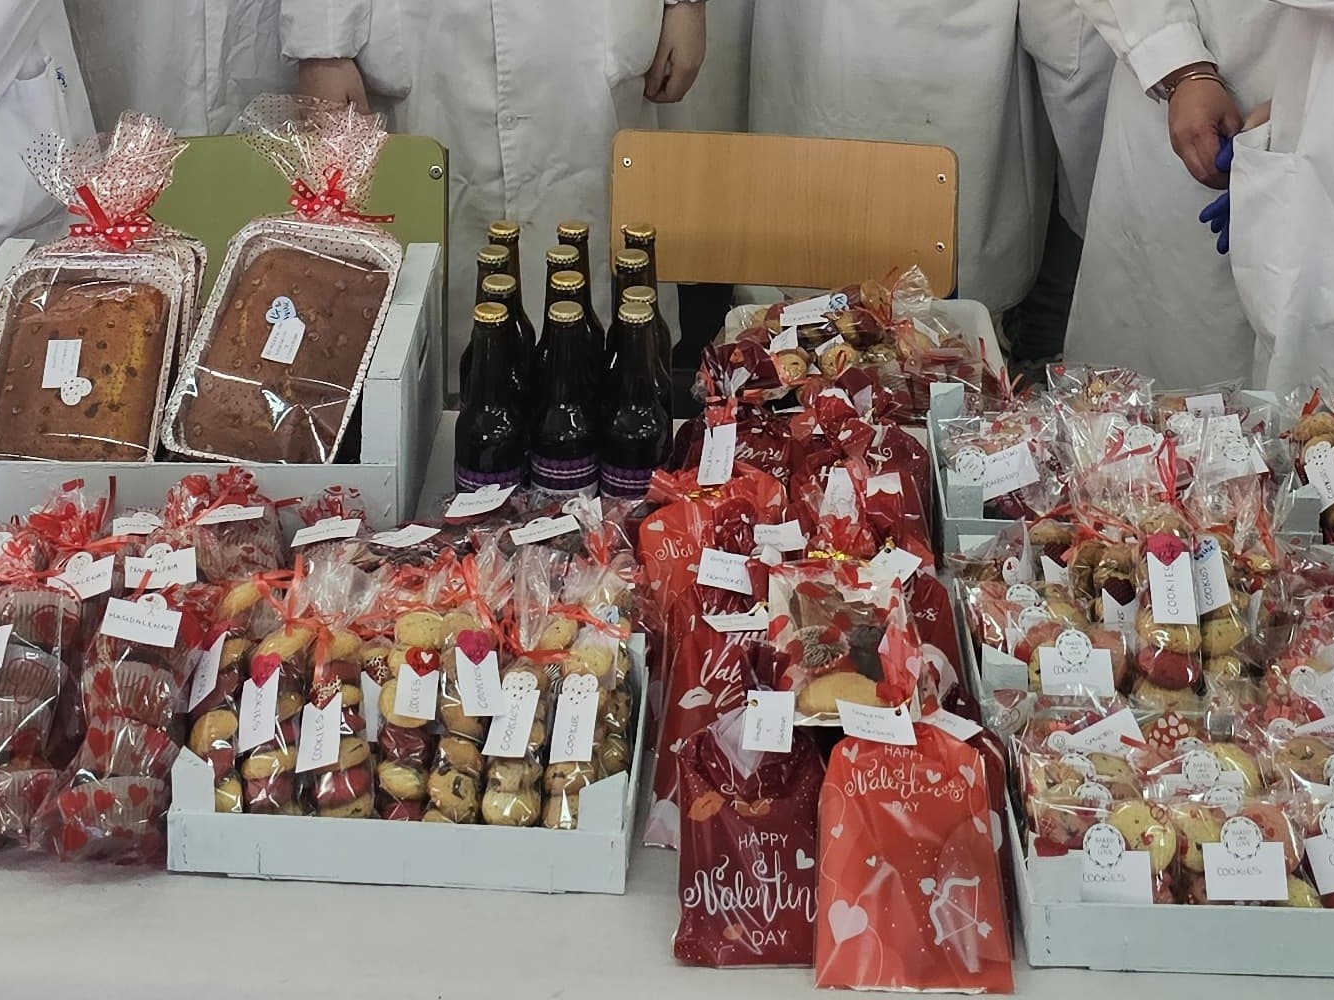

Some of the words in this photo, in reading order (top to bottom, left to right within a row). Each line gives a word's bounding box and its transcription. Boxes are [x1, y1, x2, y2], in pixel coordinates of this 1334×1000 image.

[884, 744, 924, 761] HAPPY
[892, 800, 920, 813] DAY
[738, 832, 788, 850] HAPPY
[1082, 871, 1127, 884] COOKIES
[1217, 866, 1263, 878] COOKIES
[683, 851, 818, 923] Valentin
[750, 929, 788, 946] DAY
